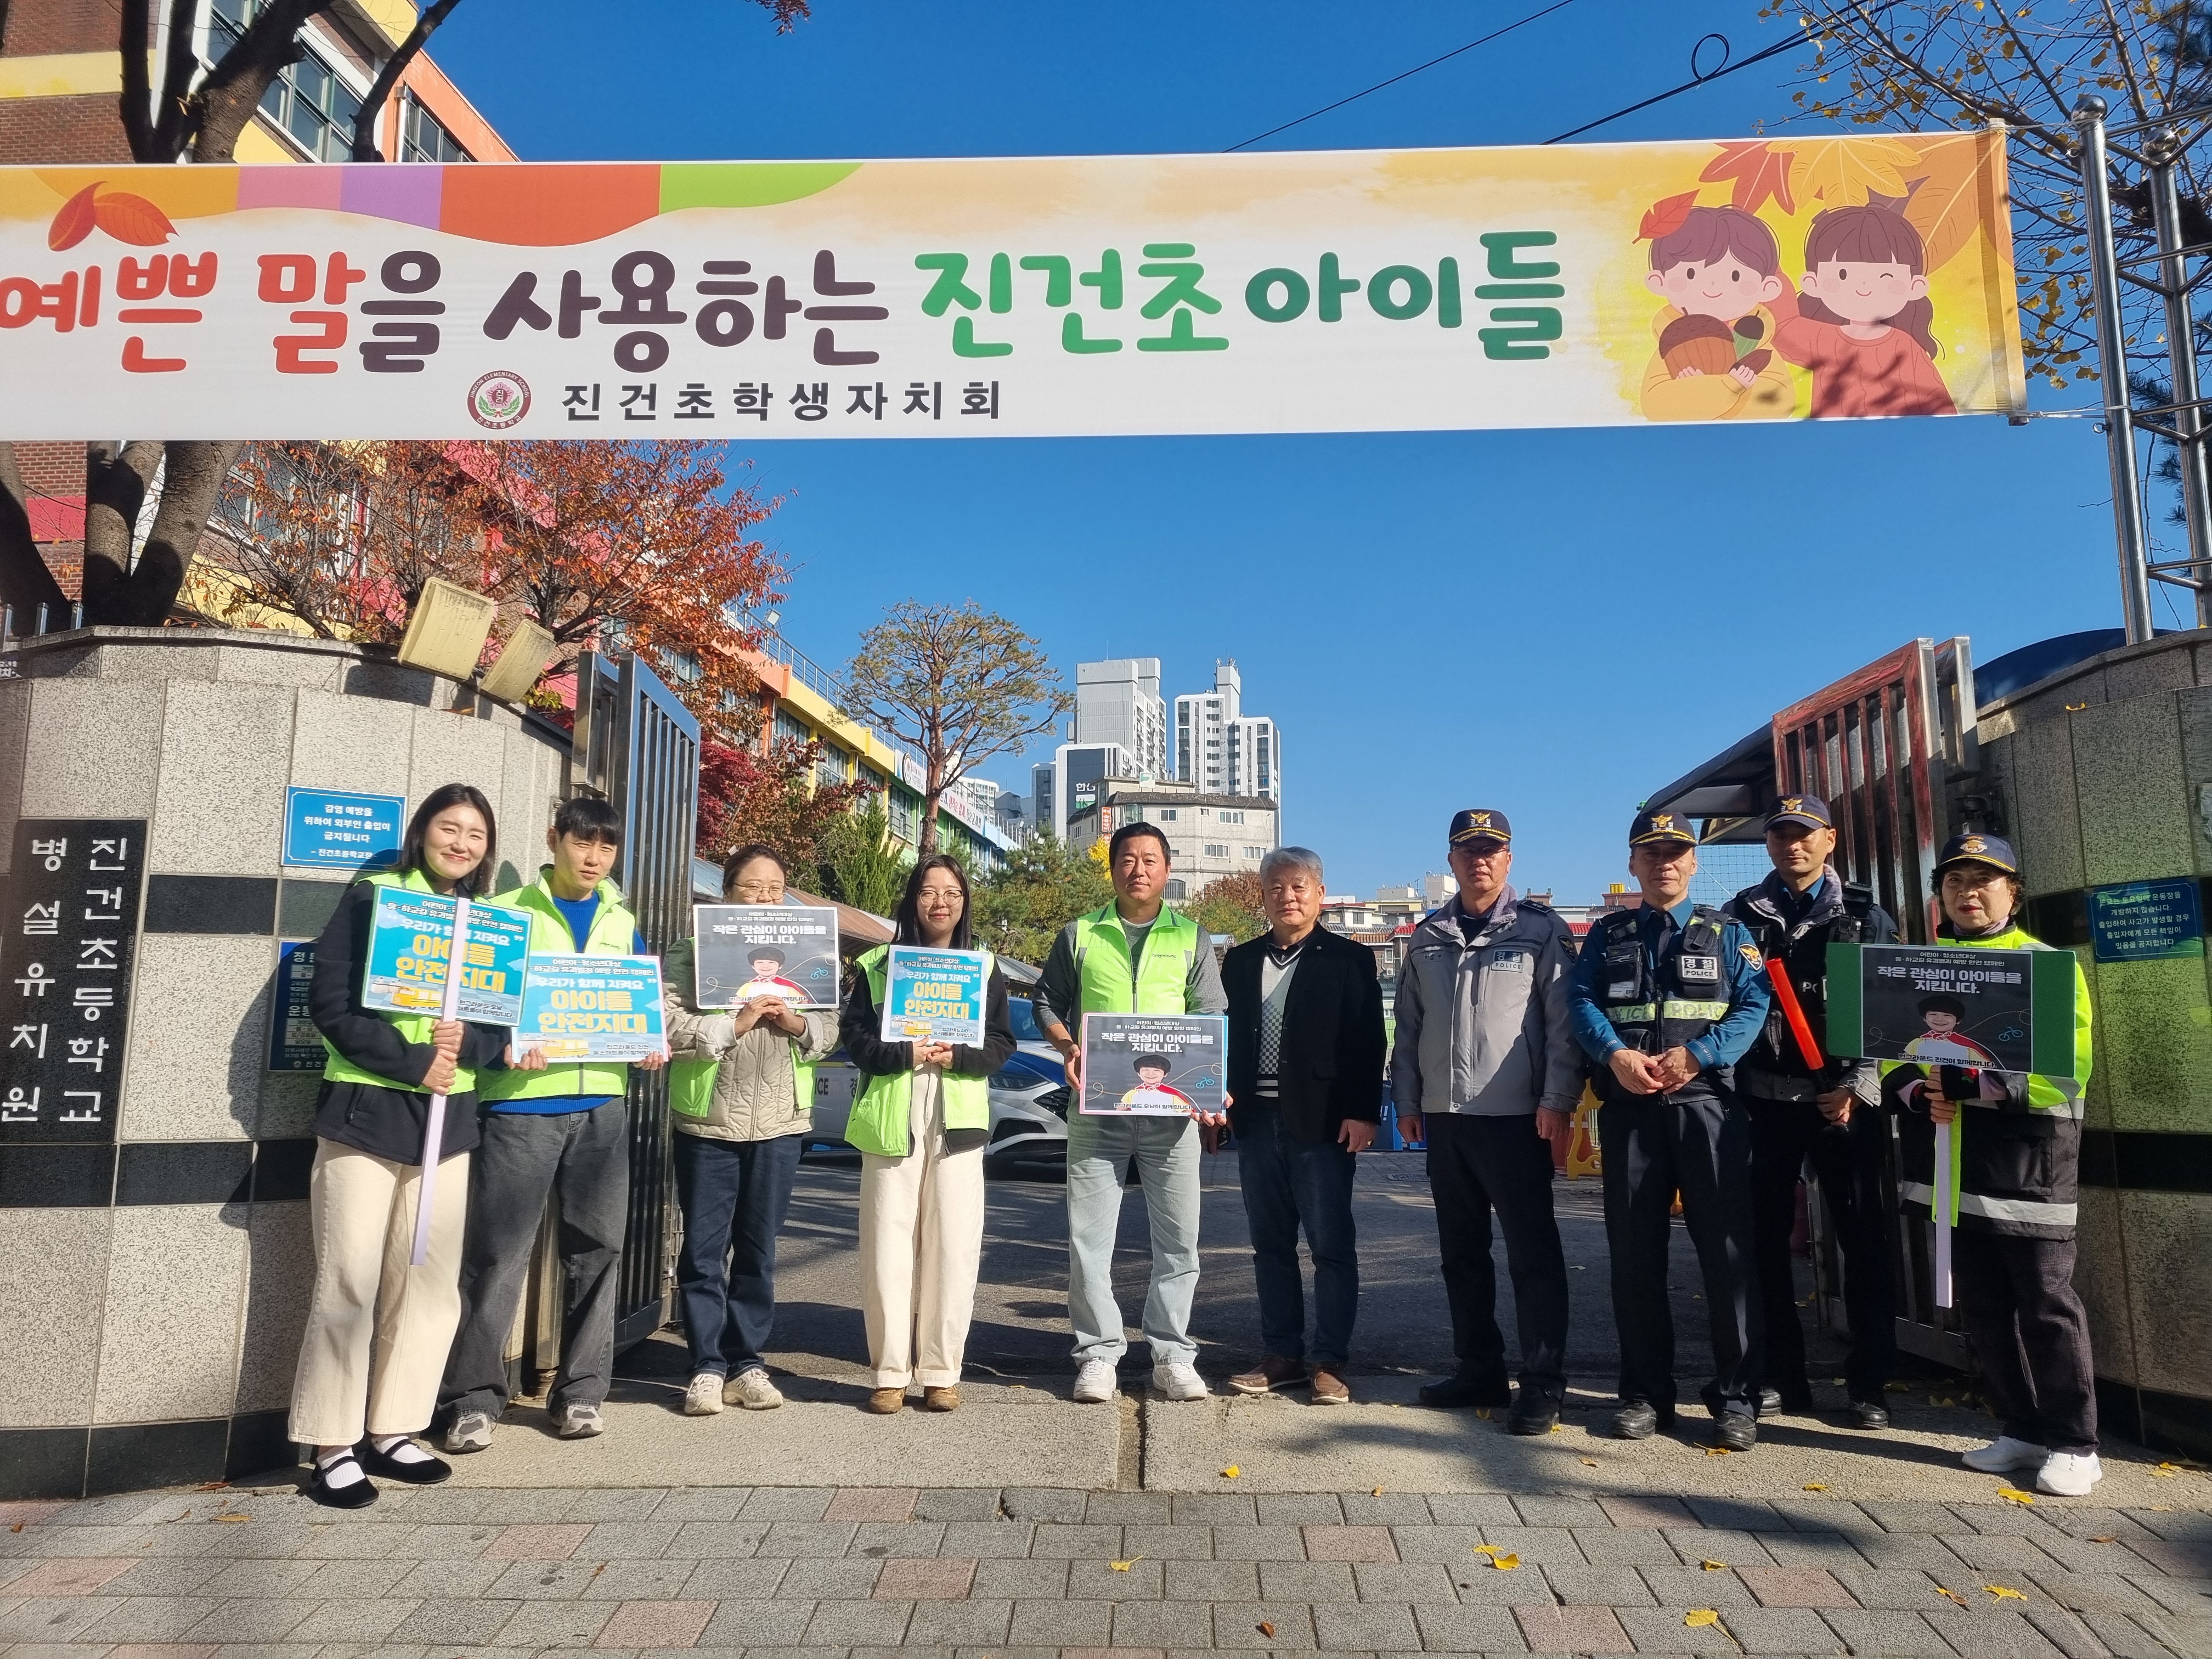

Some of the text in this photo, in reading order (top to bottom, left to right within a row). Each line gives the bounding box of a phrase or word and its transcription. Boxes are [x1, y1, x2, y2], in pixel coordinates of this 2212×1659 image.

[0, 230, 1566, 373] 예쁜 말을 사용하는 진건초 아이들
[484, 371, 518, 380] ELEMENTARY
[517, 379, 530, 398] SCHOOL
[561, 380, 1000, 422] 진건초학생자치회
[325, 804, 374, 817] 감염 예방을
[304, 816, 391, 831] 위하여 외부인 출입이
[324, 831, 371, 843] 금지됩니다
[2122, 894, 2151, 903] 토요일에
[2152, 891, 2181, 901] 운동장을
[2111, 907, 2139, 916] 개방하지
[2099, 920, 2126, 928] 출입하여
[2152, 916, 2172, 924] 발생할
[2176, 914, 2190, 922] 경우
[400, 918, 441, 934] 우리가
[473, 930, 510, 946] 지켜요
[712, 925, 827, 935] 작은 관심이 아이들을
[2107, 930, 2141, 939] 출입자에게
[744, 935, 797, 944] 지킵니다.
[2115, 939, 2174, 950] 있음을 공지합니다
[2, 837, 67, 1122] 병설유치원
[59, 838, 128, 1122] 진건초등학교
[907, 971, 971, 983] 우리가 함께 지켜요
[1877, 966, 2022, 984] 작은 관심이 아이들을
[535, 977, 645, 990] 우리가 함께 지켜요
[913, 981, 962, 1000] 아이들
[1915, 980, 1980, 994] 지킵니다.
[550, 989, 633, 1011] 아이들
[905, 999, 970, 1019] 안전지대
[1671, 1002, 1727, 1018] POLIC
[538, 1012, 648, 1034] 안전지대
[1101, 1032, 1214, 1045] 작은 관심이 아이들을
[1131, 1043, 1183, 1053] 지킵니다.
[815, 1077, 829, 1096] ICE
